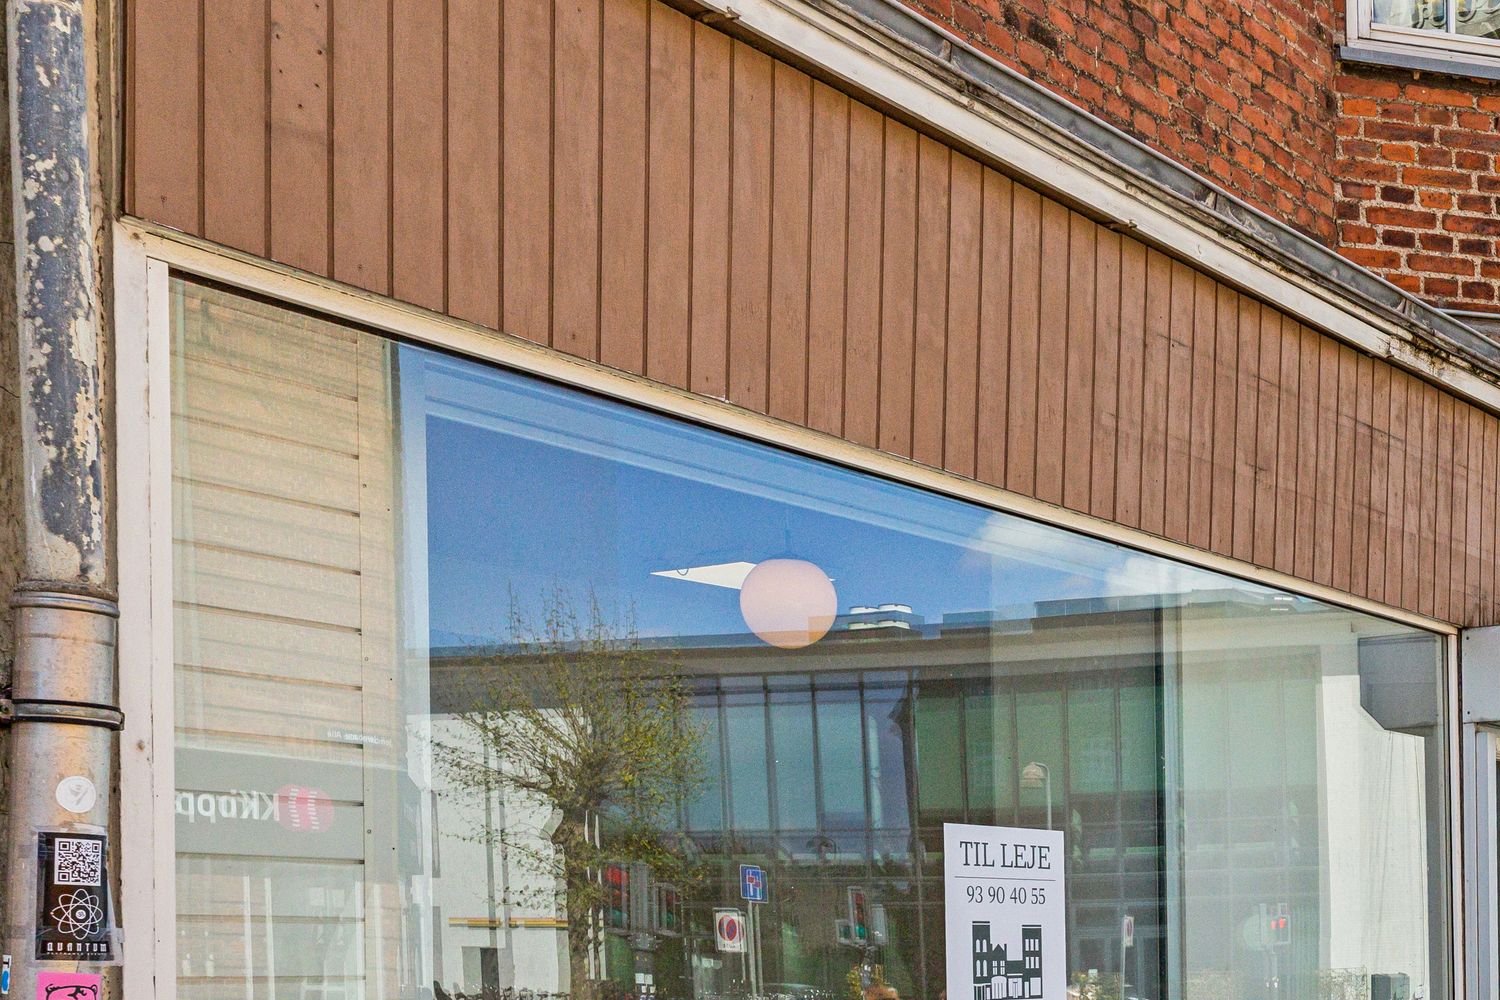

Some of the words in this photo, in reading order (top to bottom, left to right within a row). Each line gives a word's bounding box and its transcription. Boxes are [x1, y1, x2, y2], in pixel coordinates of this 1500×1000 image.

[960, 841, 995, 867] TIL
[1000, 843, 1051, 870] LEJE
[966, 885, 984, 904] 93
[988, 886, 1005, 904] 90
[1009, 886, 1027, 905] 40
[1031, 887, 1046, 905] 55
[47, 942, 107, 952] QUANTUM
